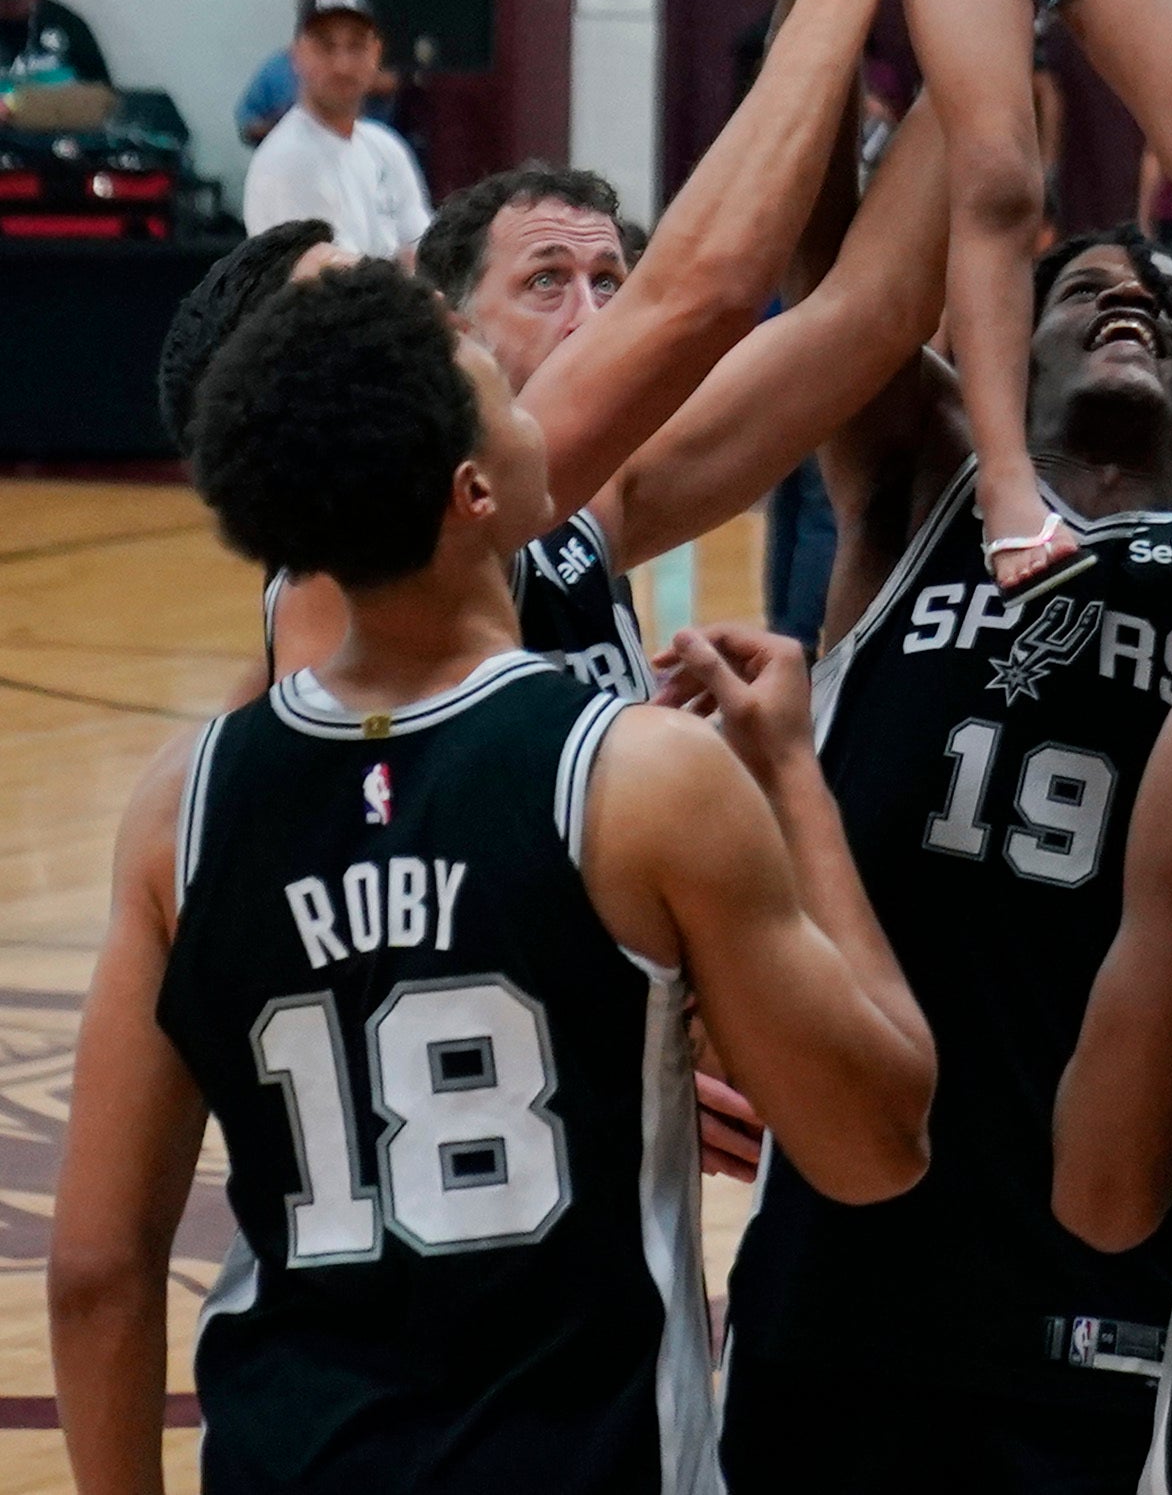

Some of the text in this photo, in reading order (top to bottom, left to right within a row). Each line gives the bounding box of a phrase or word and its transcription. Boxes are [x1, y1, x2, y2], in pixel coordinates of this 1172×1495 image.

[556, 536, 596, 585] elf.
[922, 717, 1117, 888] 19
[285, 857, 467, 969] ROBY
[249, 972, 572, 1269] 18
